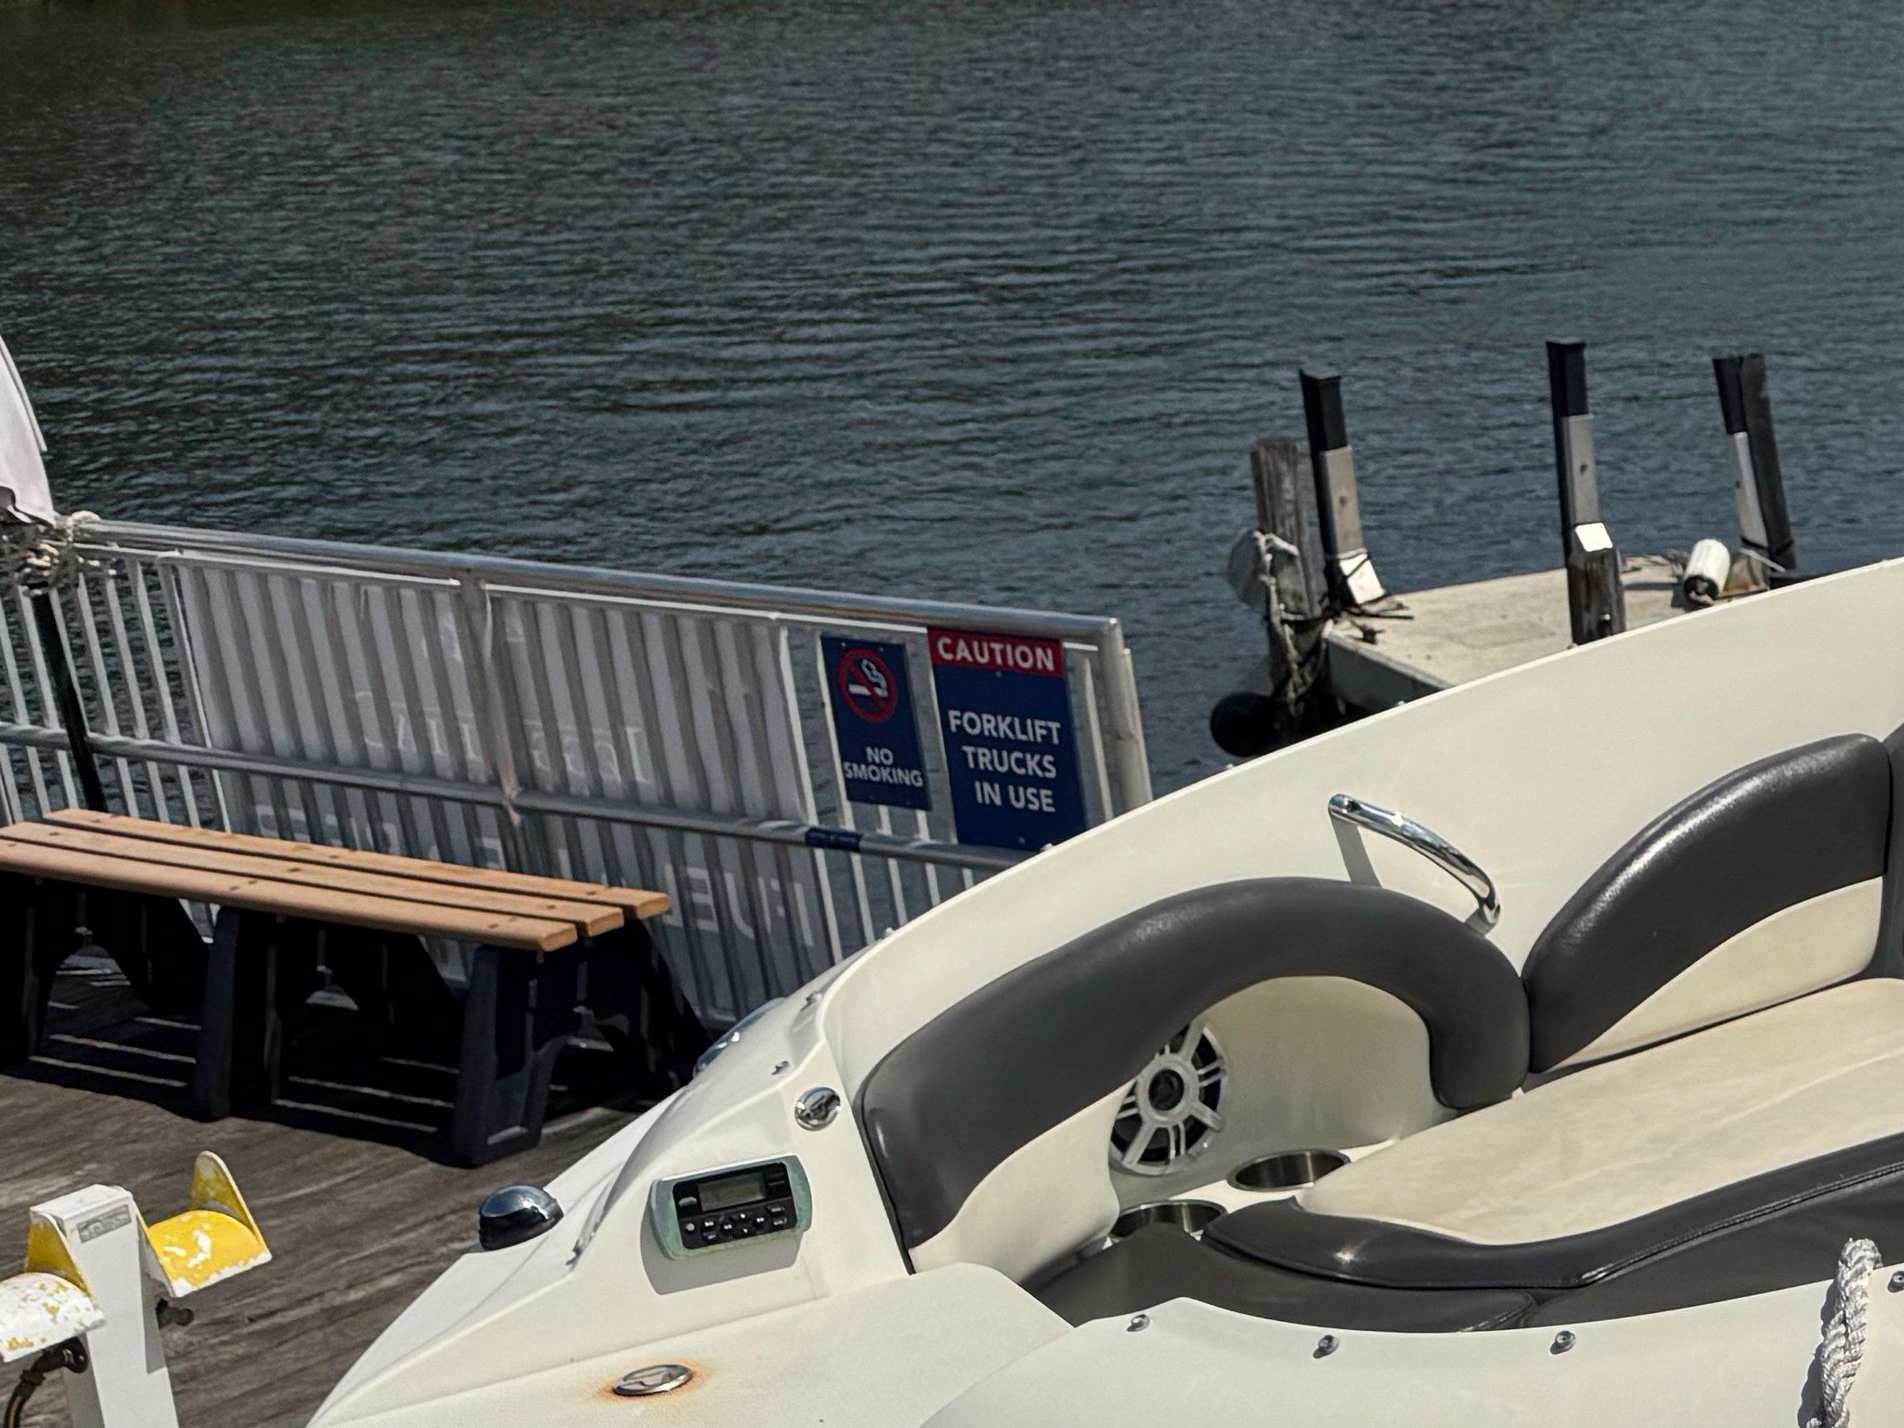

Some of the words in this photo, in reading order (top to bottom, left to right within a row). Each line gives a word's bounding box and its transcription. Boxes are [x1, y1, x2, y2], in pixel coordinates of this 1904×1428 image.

[936, 637, 1055, 672] CAUTION
[948, 709, 1060, 746] FORKLIFT
[866, 746, 894, 765] NO
[963, 745, 1056, 779] TRUCKS
[843, 761, 924, 788] SMOKING
[974, 781, 1002, 807] IN
[1010, 788, 1056, 813] USE
